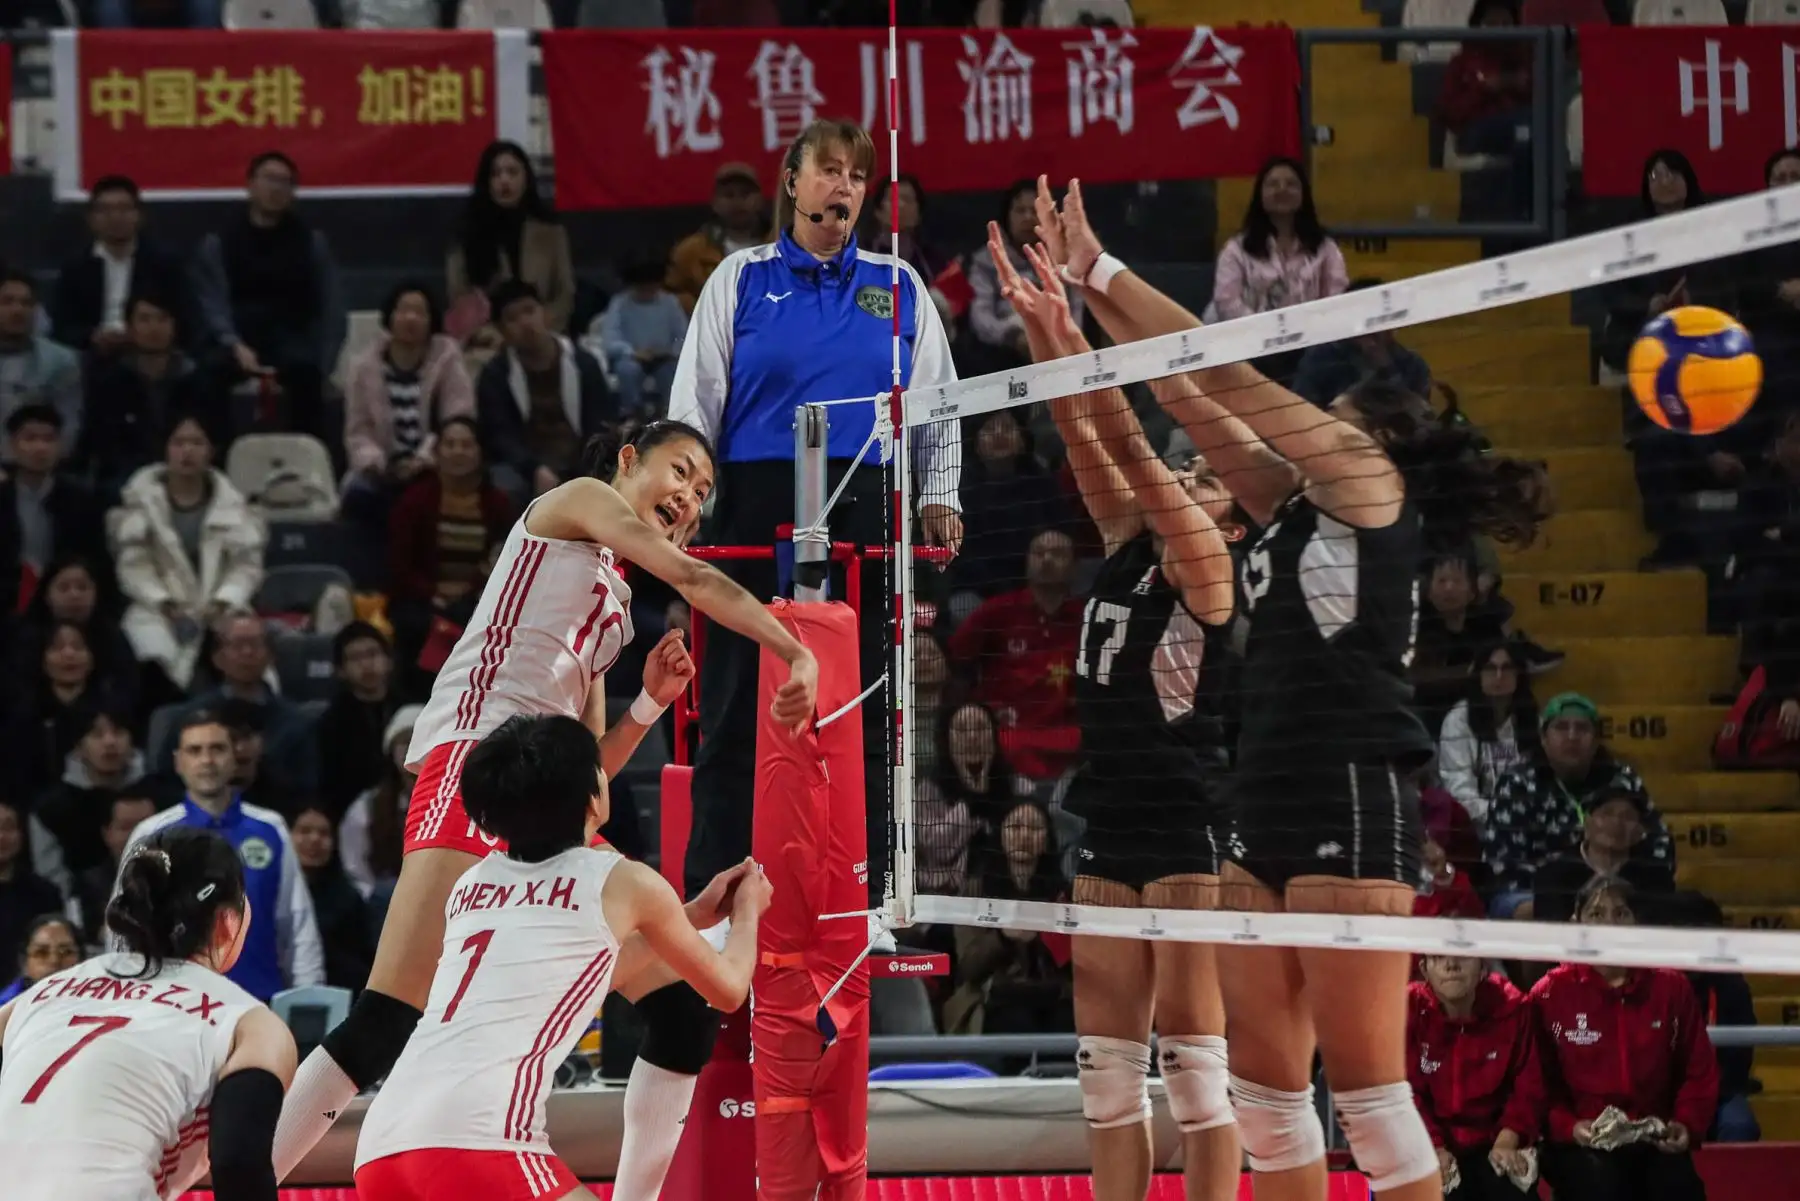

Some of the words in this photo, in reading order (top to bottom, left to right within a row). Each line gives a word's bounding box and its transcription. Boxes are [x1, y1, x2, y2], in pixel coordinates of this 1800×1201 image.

[642, 25, 1245, 158] 秘鲁川渝商会
[1539, 583, 1604, 606] E-07
[1076, 597, 1131, 686] 17
[1668, 823, 1727, 849] -05
[449, 882, 516, 920] CHEN
[516, 876, 580, 912] X.H.
[900, 961, 933, 972] Senoh
[32, 977, 152, 1004] ZHANG
[152, 984, 224, 1026] Z.X.
[21, 1015, 132, 1104] 7
